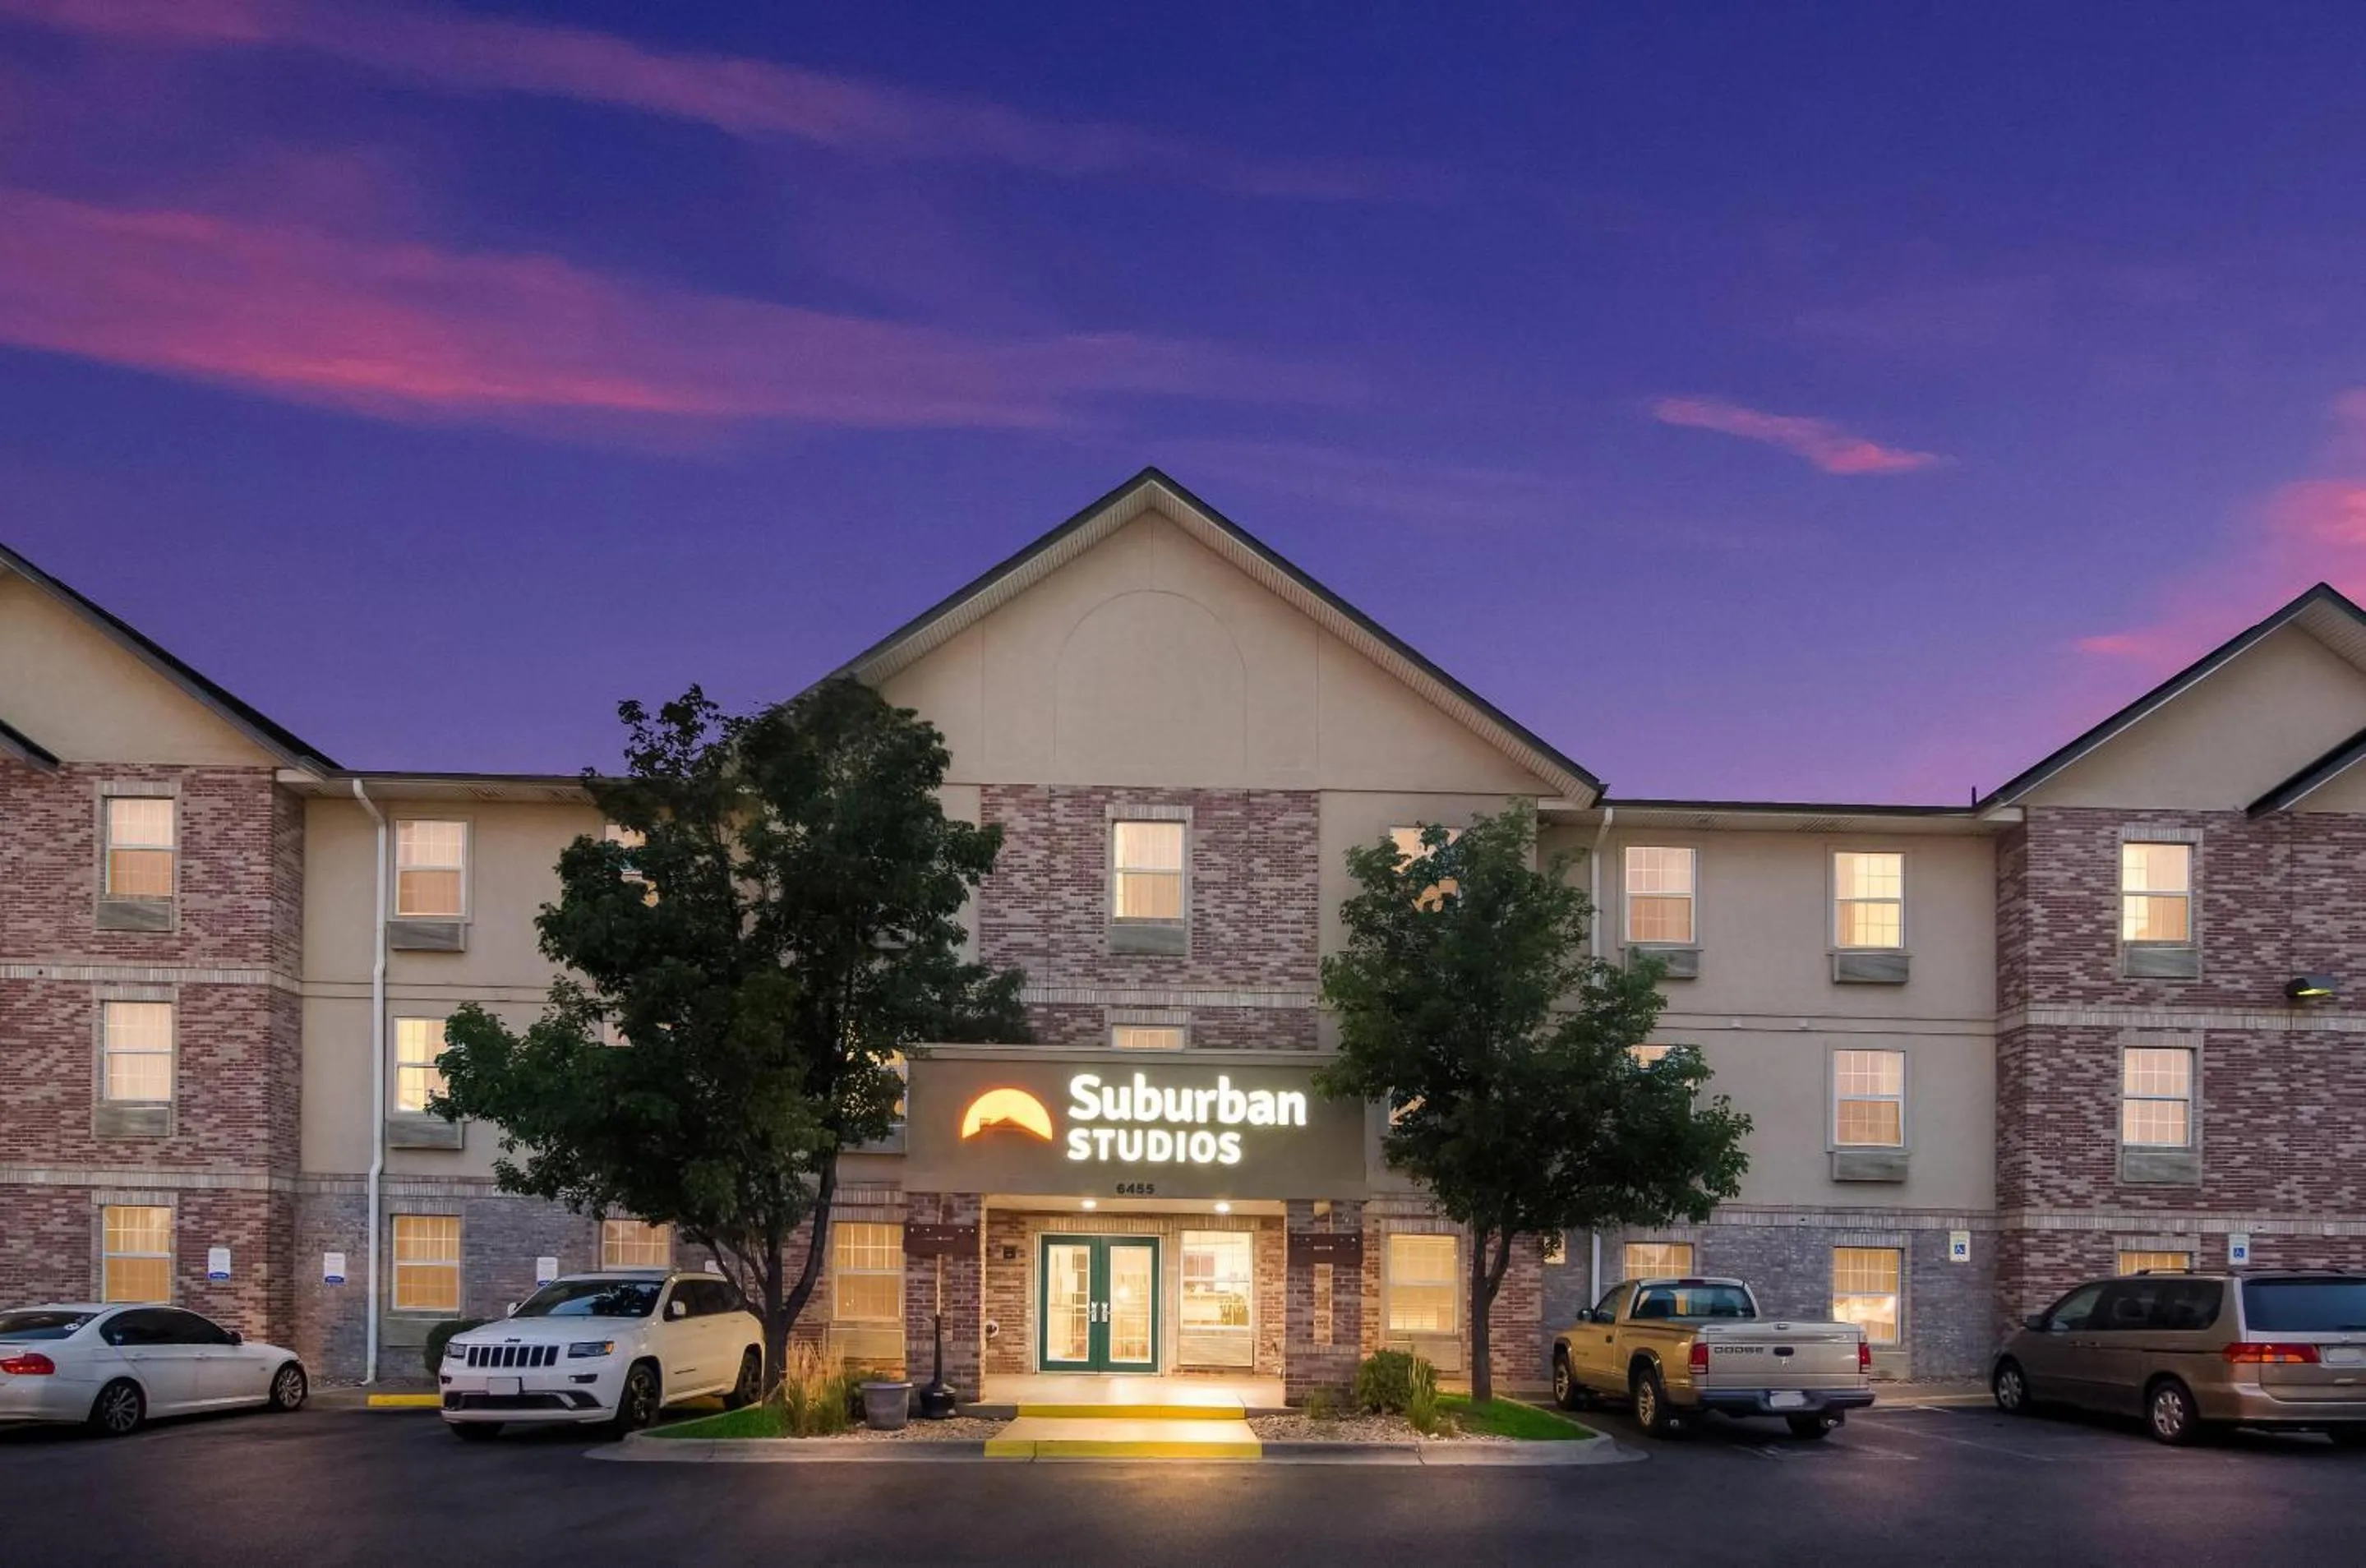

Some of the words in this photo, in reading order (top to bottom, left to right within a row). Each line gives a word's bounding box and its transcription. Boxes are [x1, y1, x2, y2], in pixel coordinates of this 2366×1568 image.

[1068, 1073, 1307, 1127] Suburban
[1068, 1128, 1242, 1165] STUDIOS
[1116, 1183, 1155, 1195] 6455
[1714, 1346, 1764, 1354] DODGE
